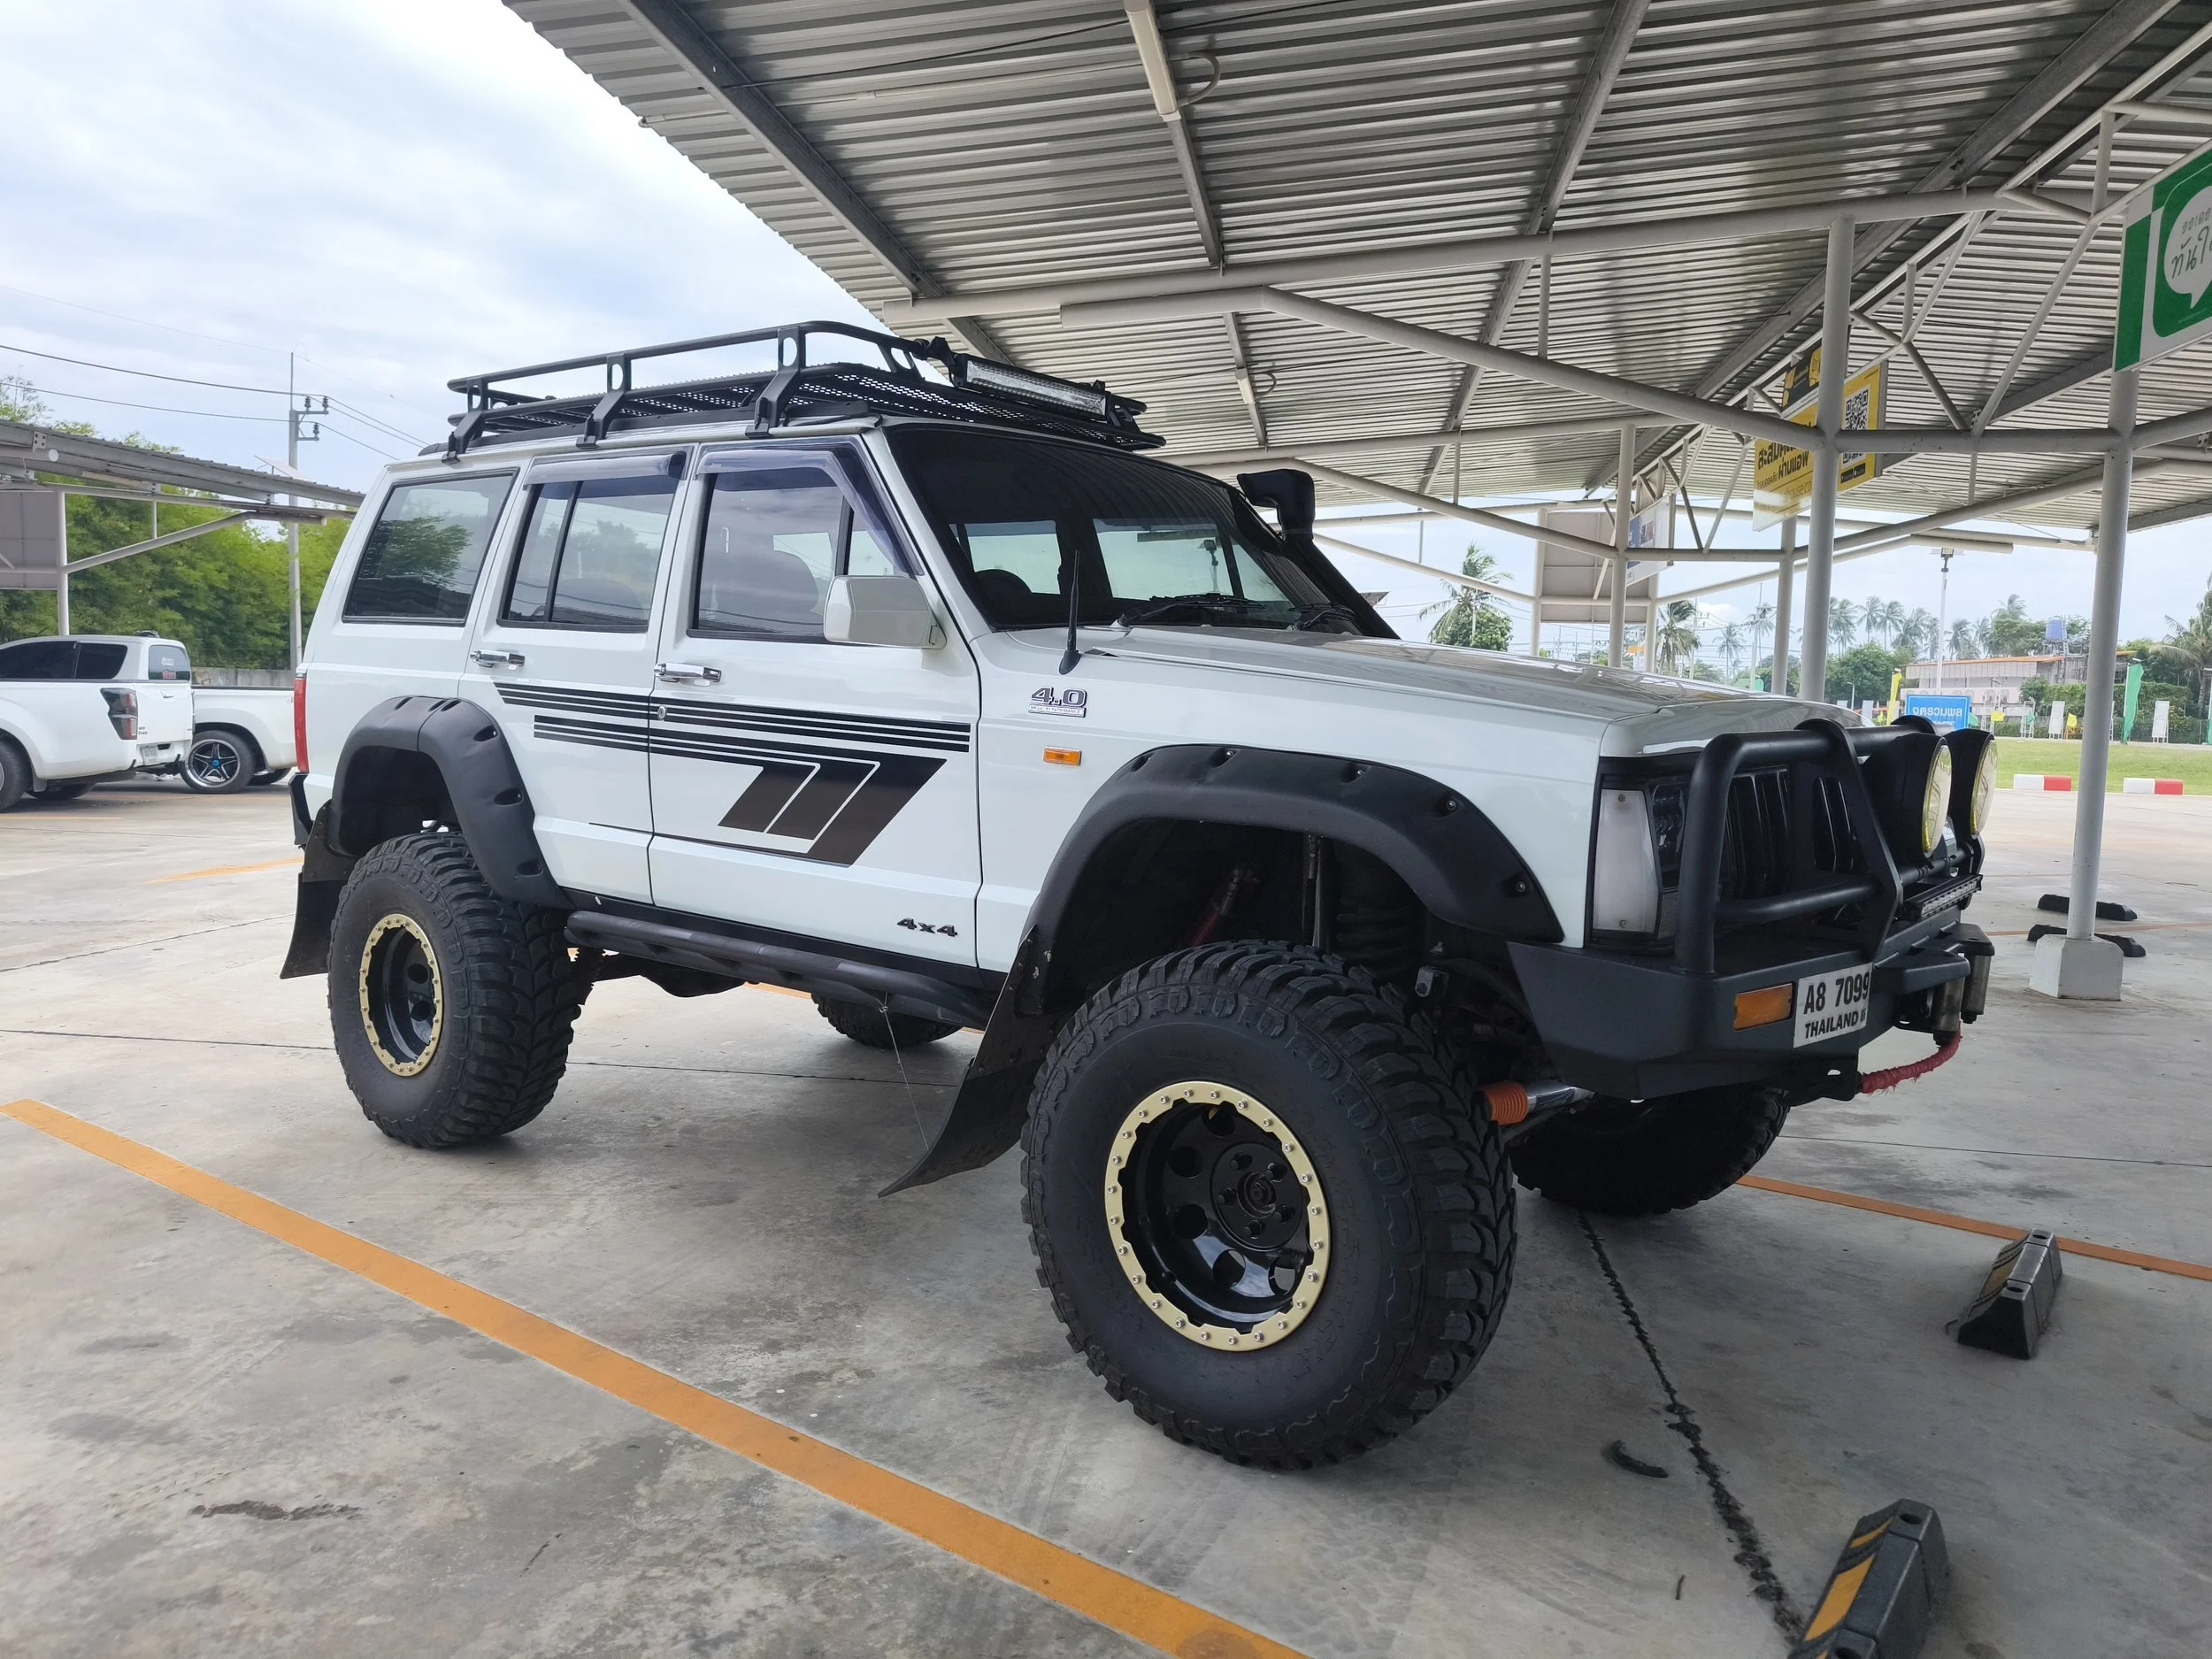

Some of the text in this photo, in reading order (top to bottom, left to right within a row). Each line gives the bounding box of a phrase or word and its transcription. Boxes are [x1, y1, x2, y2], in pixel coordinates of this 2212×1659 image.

[2171, 226, 2212, 280] ทันใ
[1030, 687, 1087, 707] 4.0
[896, 918, 958, 937] 4x4
[1803, 972, 1870, 1015] A8 7099
[1805, 1010, 1859, 1039] THAILAND
